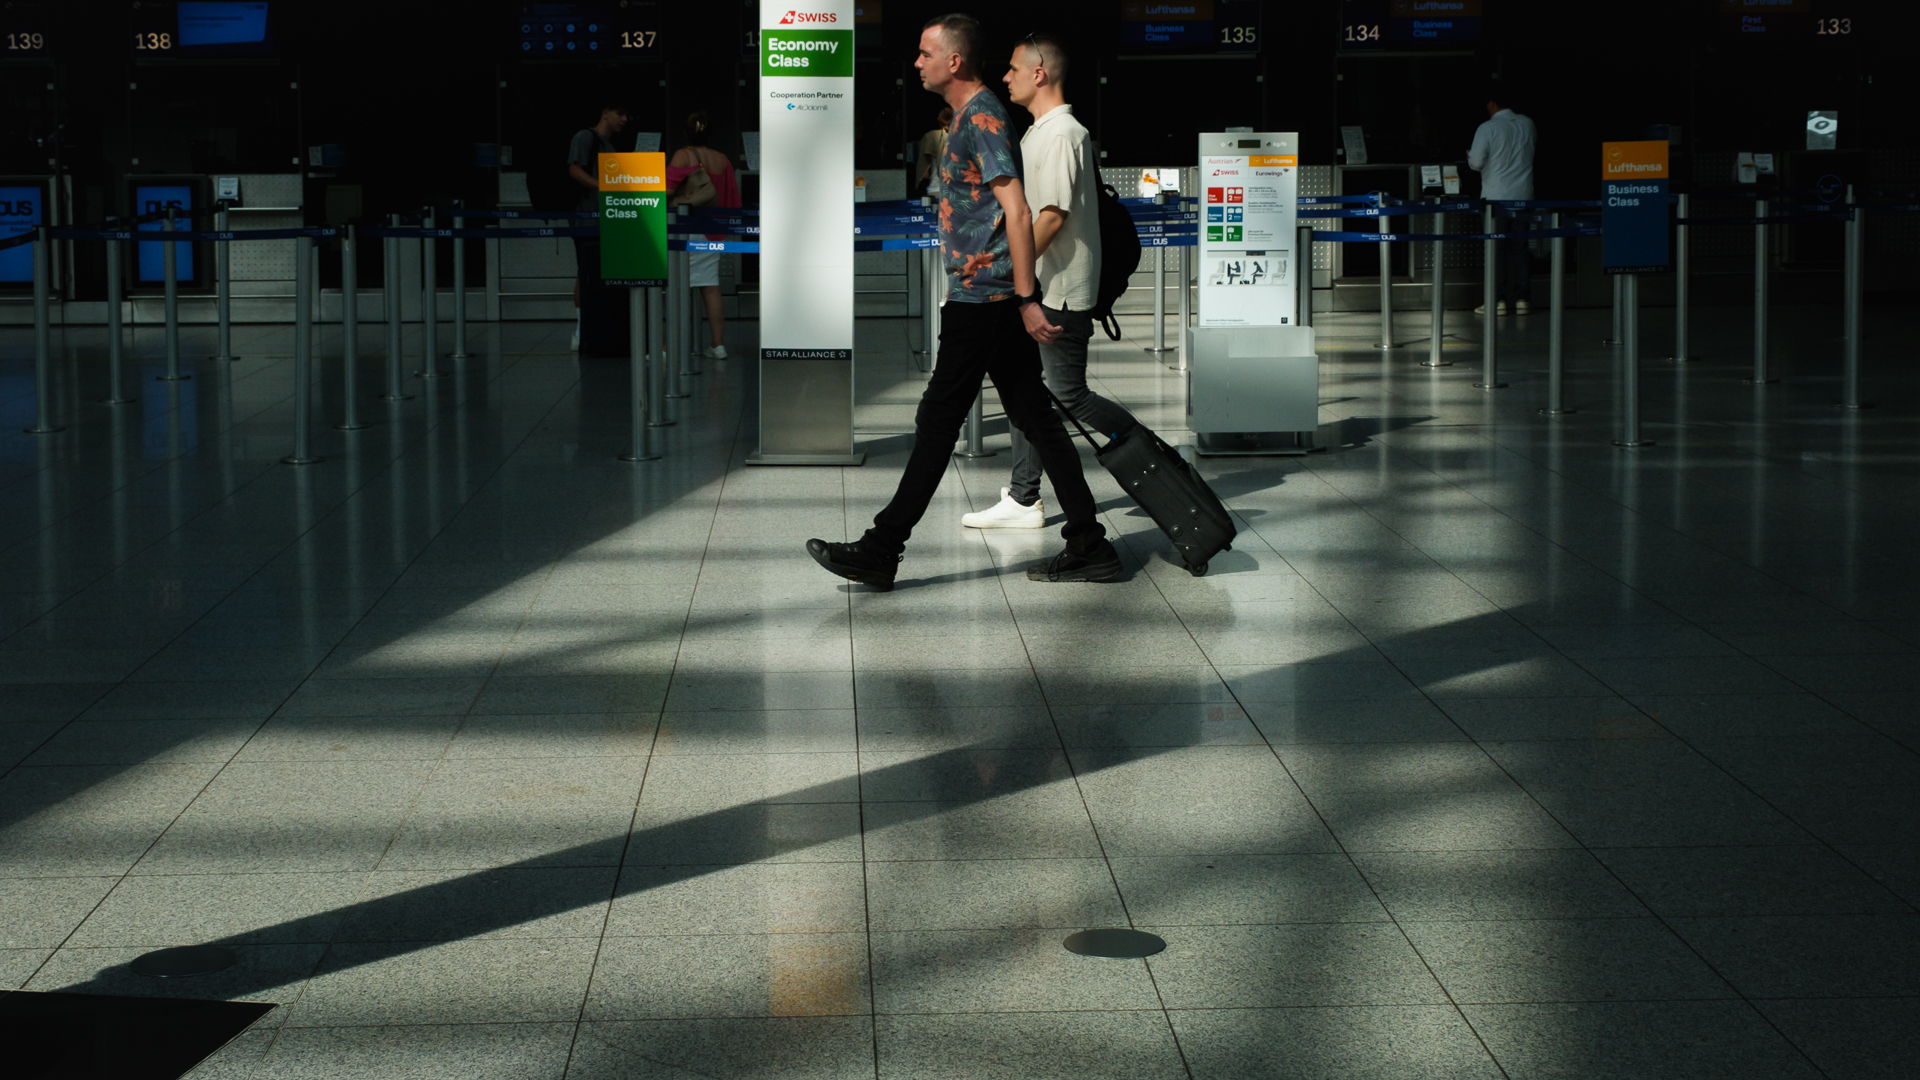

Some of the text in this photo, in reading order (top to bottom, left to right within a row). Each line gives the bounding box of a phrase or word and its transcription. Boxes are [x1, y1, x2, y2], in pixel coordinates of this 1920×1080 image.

[1145, 4, 1196, 15] Lufthansa
[1414, 1, 1465, 11] Lufthansa
[797, 12, 838, 23] SWISS
[1742, 15, 1763, 24] First
[1145, 23, 1186, 33] Business
[1413, 20, 1454, 29] Business
[1741, 24, 1767, 33] Class
[1816, 18, 1852, 35] 133
[1145, 33, 1170, 42] Class
[1220, 26, 1257, 44] 135
[1344, 23, 1381, 42] 134
[1413, 29, 1438, 38] Class
[7, 32, 44, 51] 139
[135, 32, 172, 51] 138
[620, 30, 657, 49] 137
[768, 37, 839, 54] Economy
[767, 53, 810, 68] Class
[770, 91, 844, 100] Cooperation Partner
[1608, 162, 1663, 173] Lufthansa
[605, 174, 661, 184] Lufthansa
[1608, 184, 1660, 195] Business
[605, 195, 660, 208] Economy
[1608, 197, 1640, 207] Class
[605, 208, 638, 219] Class
[708, 243, 725, 251] DUS
[765, 350, 836, 359] STAR ALLIANCE
